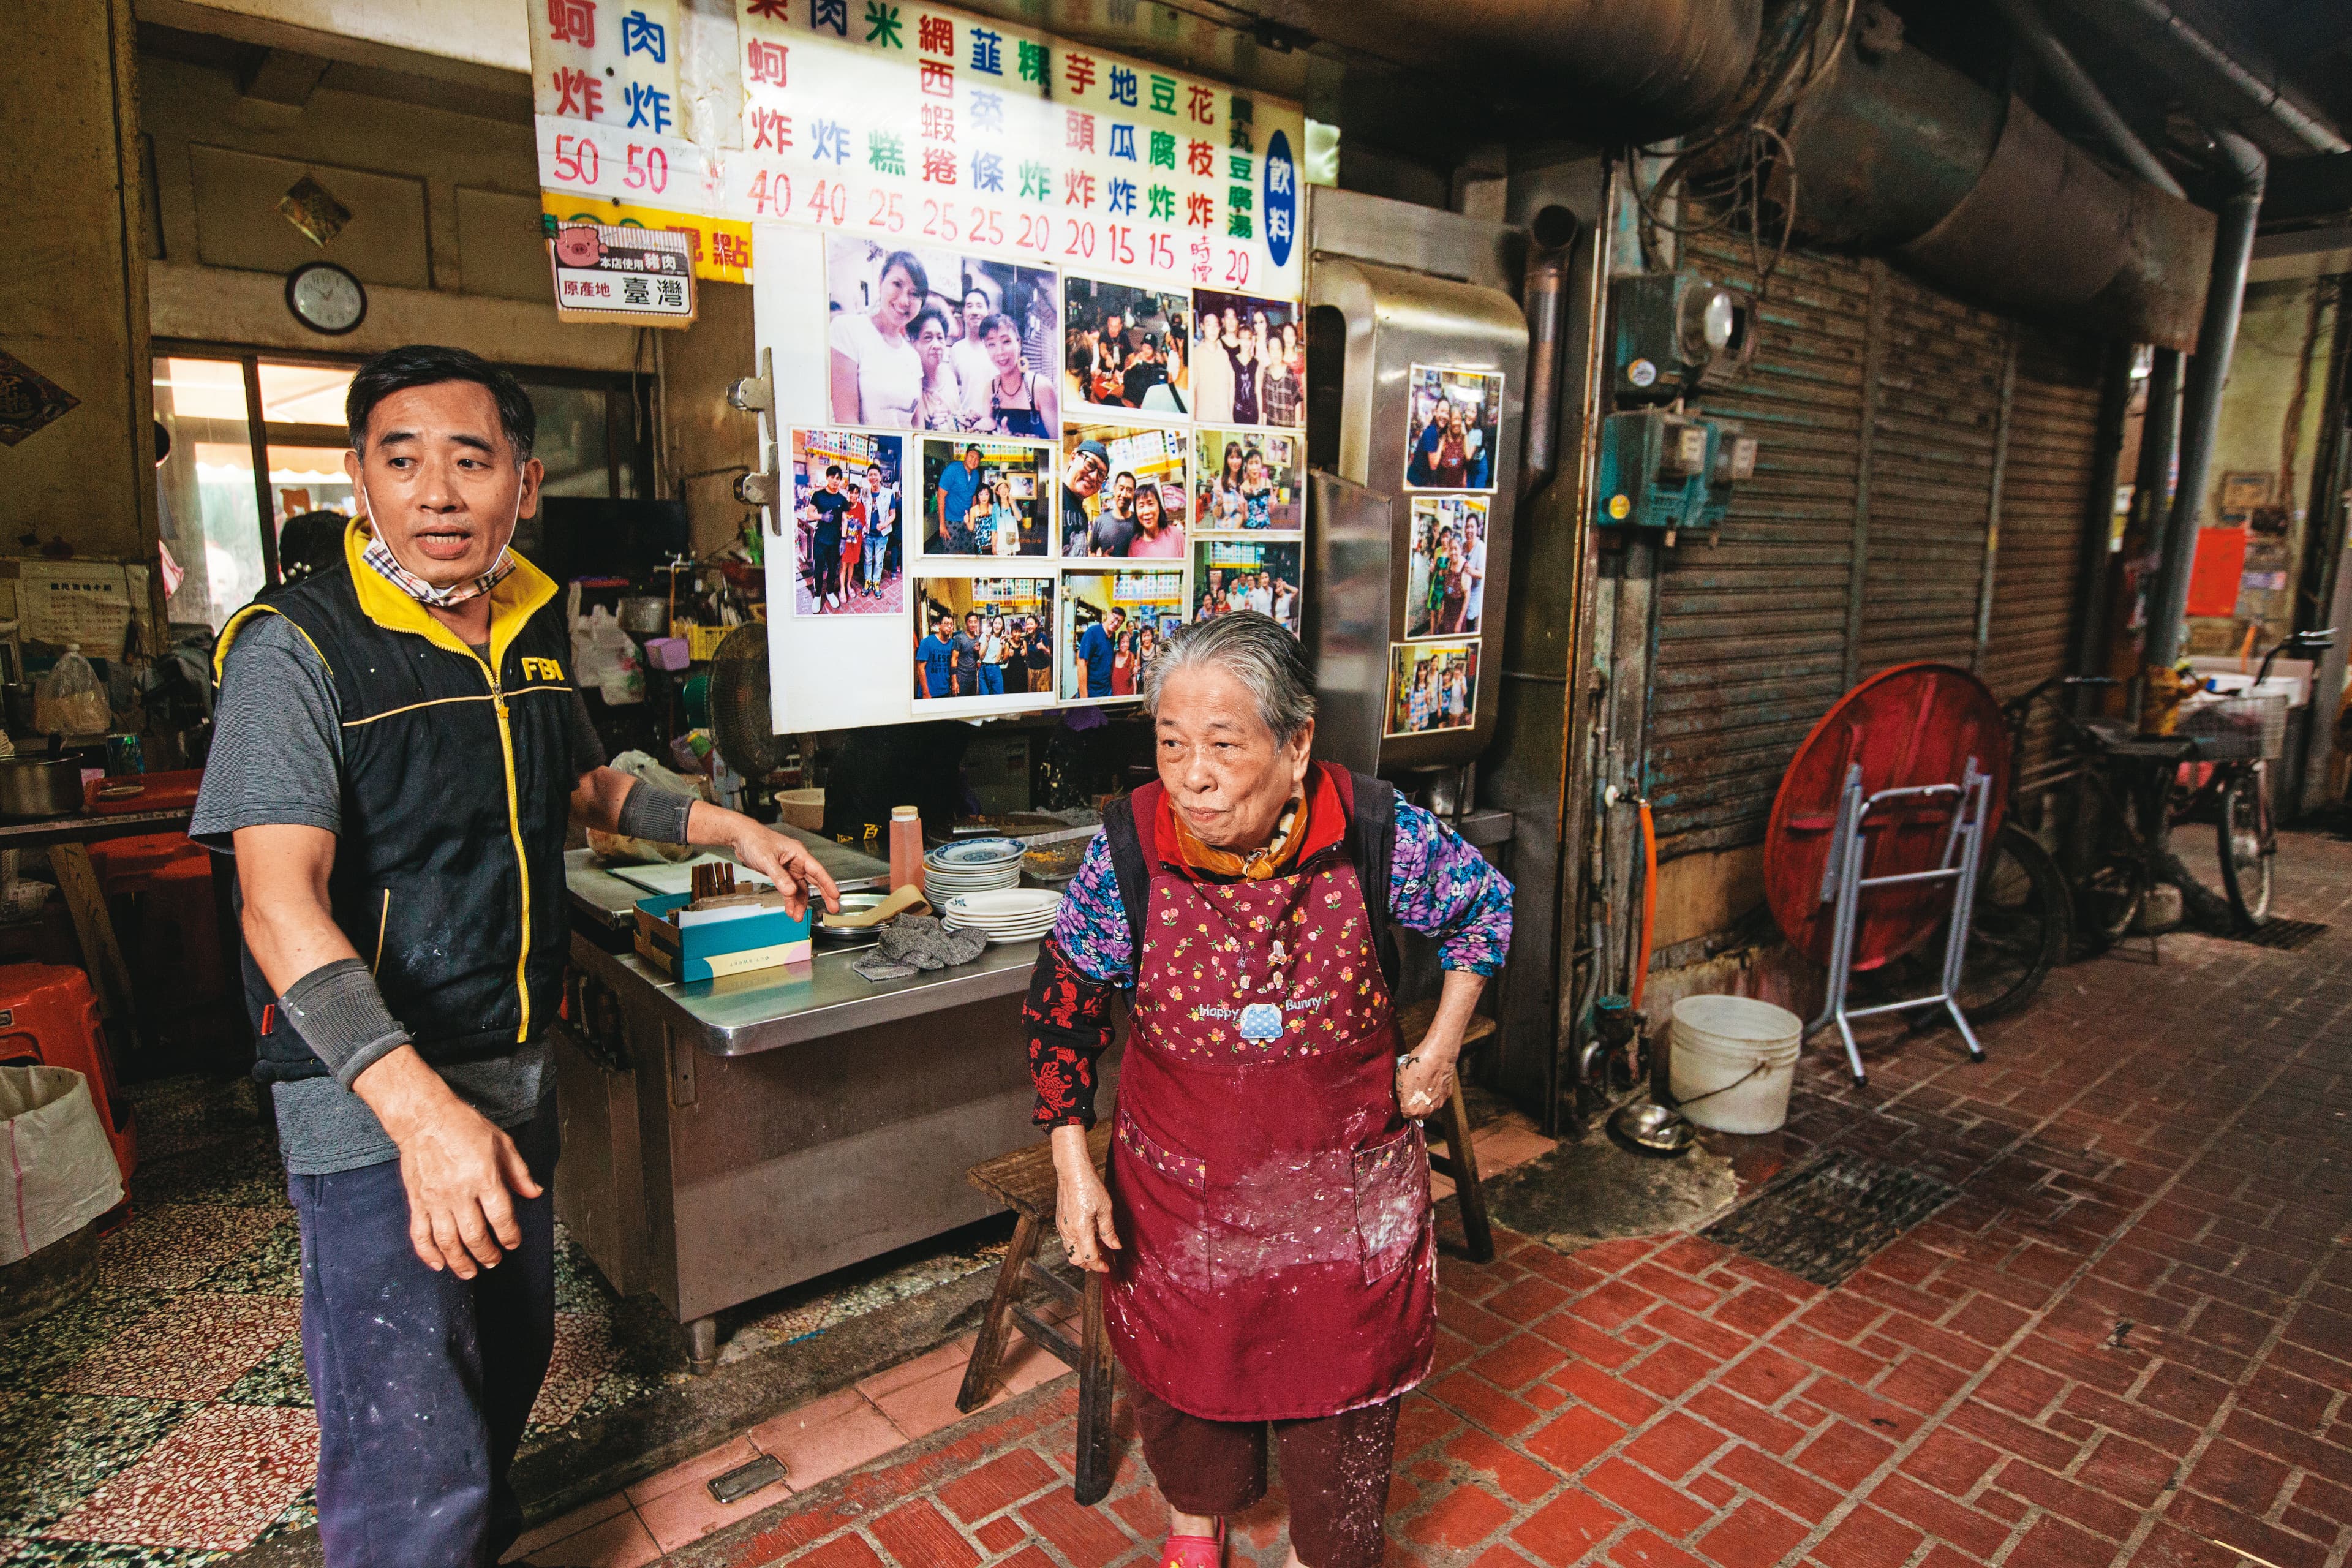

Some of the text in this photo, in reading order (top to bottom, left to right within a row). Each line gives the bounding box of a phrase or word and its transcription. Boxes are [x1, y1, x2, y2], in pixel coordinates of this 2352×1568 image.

[547, 0, 604, 121] 蚵炸
[622, 10, 673, 134] 肉炸
[864, 6, 906, 176] 米糕
[919, 13, 958, 186] 網西蝦捲
[554, 133, 668, 194] 50 50
[1065, 53, 1096, 209] 芋頭炸
[1108, 64, 1138, 216] 地瓜炸
[1148, 73, 1177, 222] 豆腐炸
[1186, 84, 1215, 229] 花枝炸
[747, 168, 1250, 285] 40 40 25 25 25 20 20 15 15 時價 20
[1268, 155, 1292, 244] 飲料
[564, 277, 682, 306] 原產地 臺灣
[521, 657, 565, 682] FBI
[1199, 995, 1322, 1022] Happy Bunny
